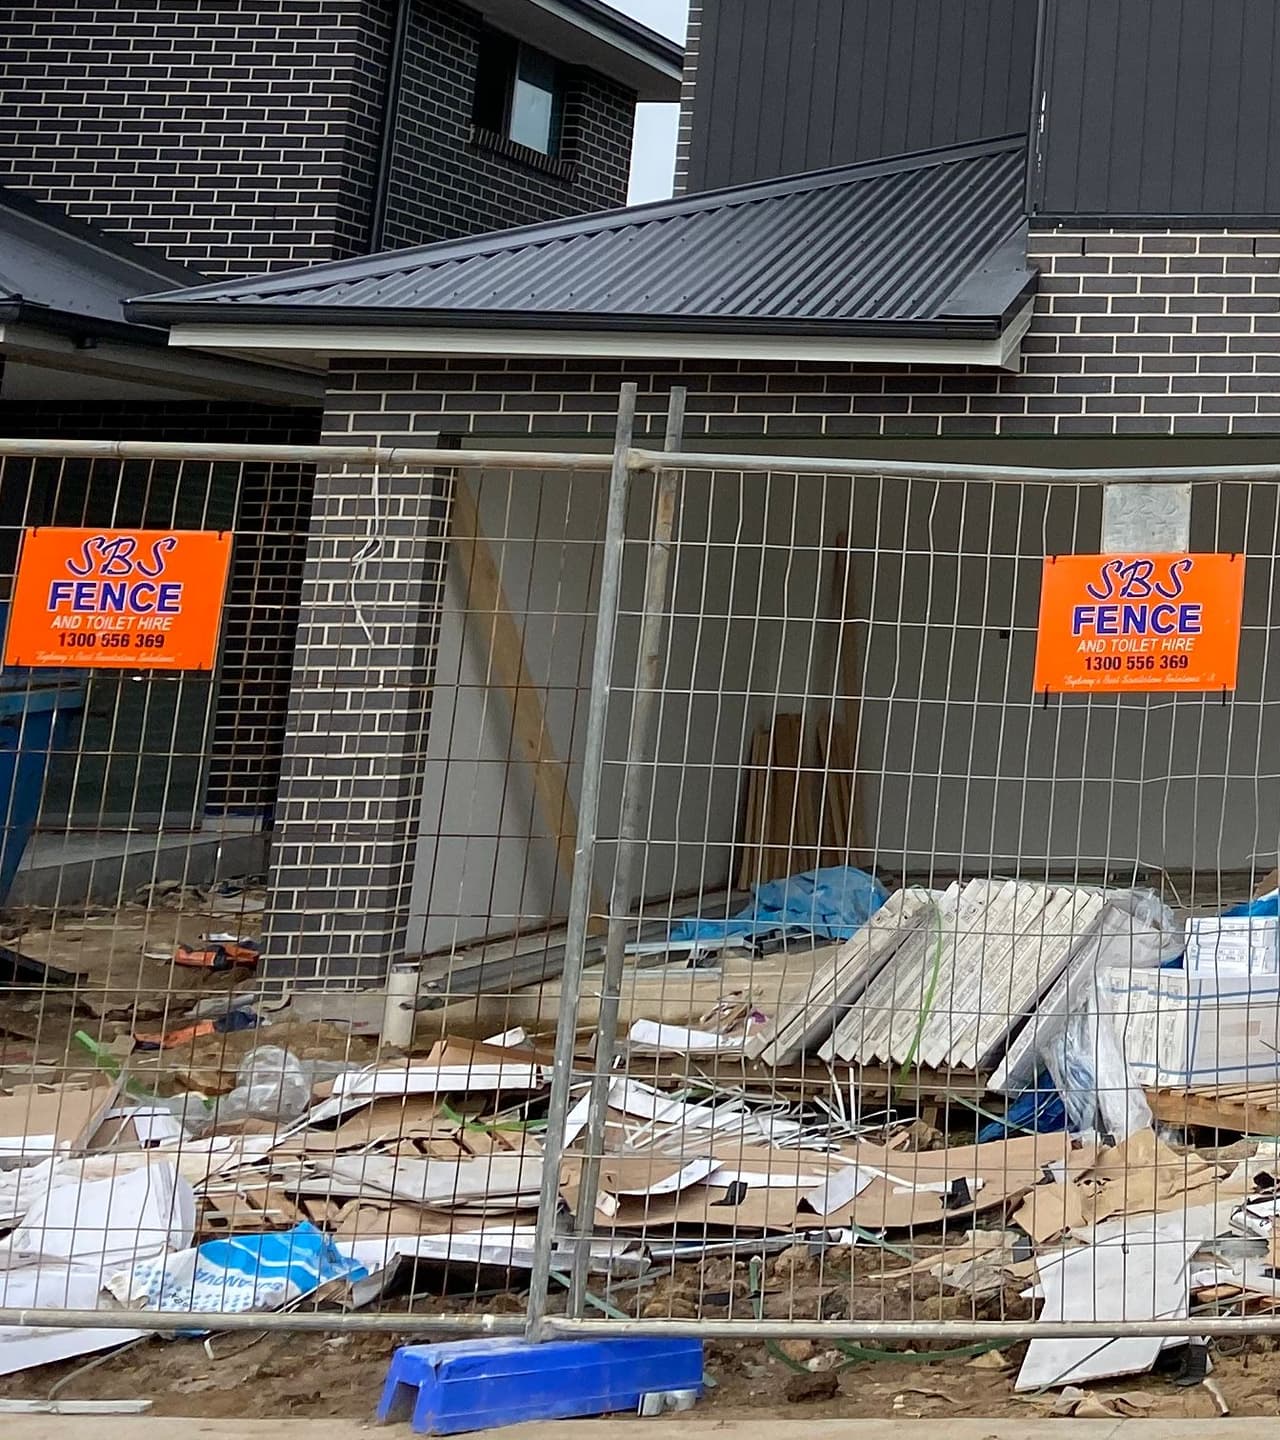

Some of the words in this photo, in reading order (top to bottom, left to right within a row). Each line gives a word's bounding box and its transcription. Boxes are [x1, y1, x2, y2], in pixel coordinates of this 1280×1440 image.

[66, 536, 176, 577] SBS
[1086, 558, 1193, 600] SBS
[48, 580, 183, 613] FENCE
[50, 615, 82, 629] AND
[87, 616, 135, 630] TOILET
[137, 617, 173, 631] HIRE
[1072, 603, 1203, 636] FENCE
[59, 632, 96, 647] 1300
[101, 633, 130, 647] 556
[135, 634, 165, 648] 369
[1077, 639, 1106, 653] AND
[1111, 638, 1156, 652] TOILET
[1161, 638, 1195, 651] HIRE
[1085, 656, 1121, 670] 1300
[1126, 656, 1154, 670] 556
[1159, 655, 1188, 669] 369
